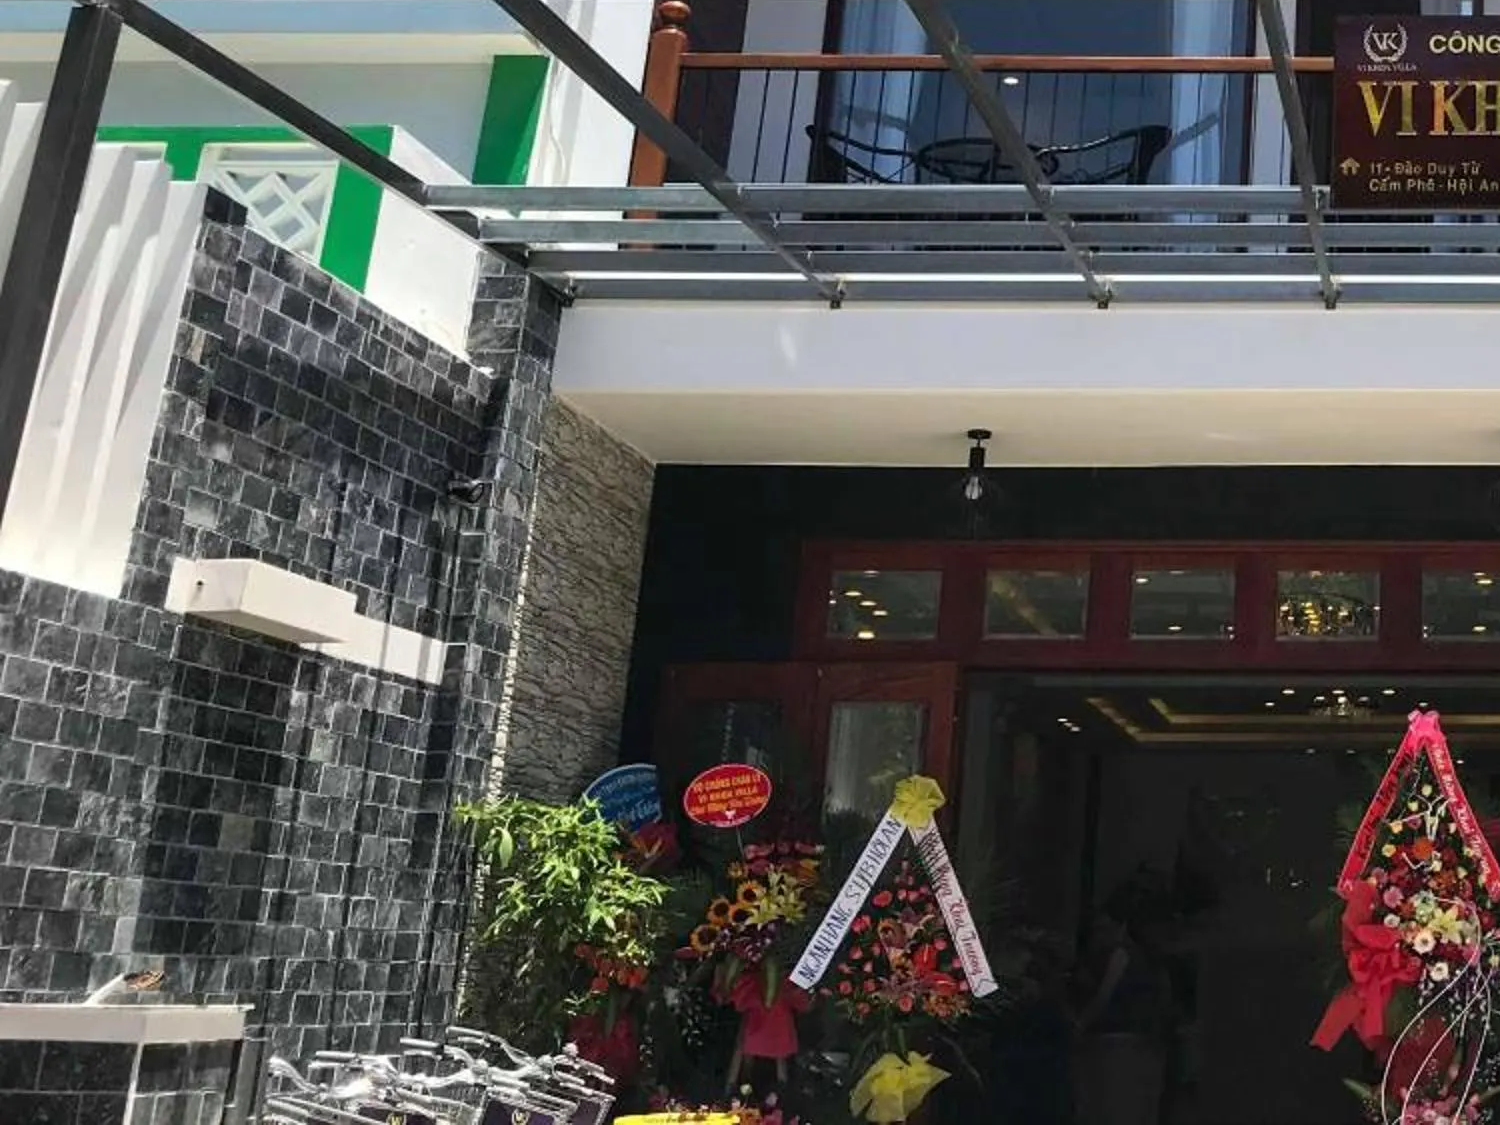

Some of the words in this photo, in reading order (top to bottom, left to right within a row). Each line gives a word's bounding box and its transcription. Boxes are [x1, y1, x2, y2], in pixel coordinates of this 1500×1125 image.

[1357, 80, 1417, 136] VI
[1427, 162, 1456, 177] Duy
[1479, 179, 1500, 191] An
